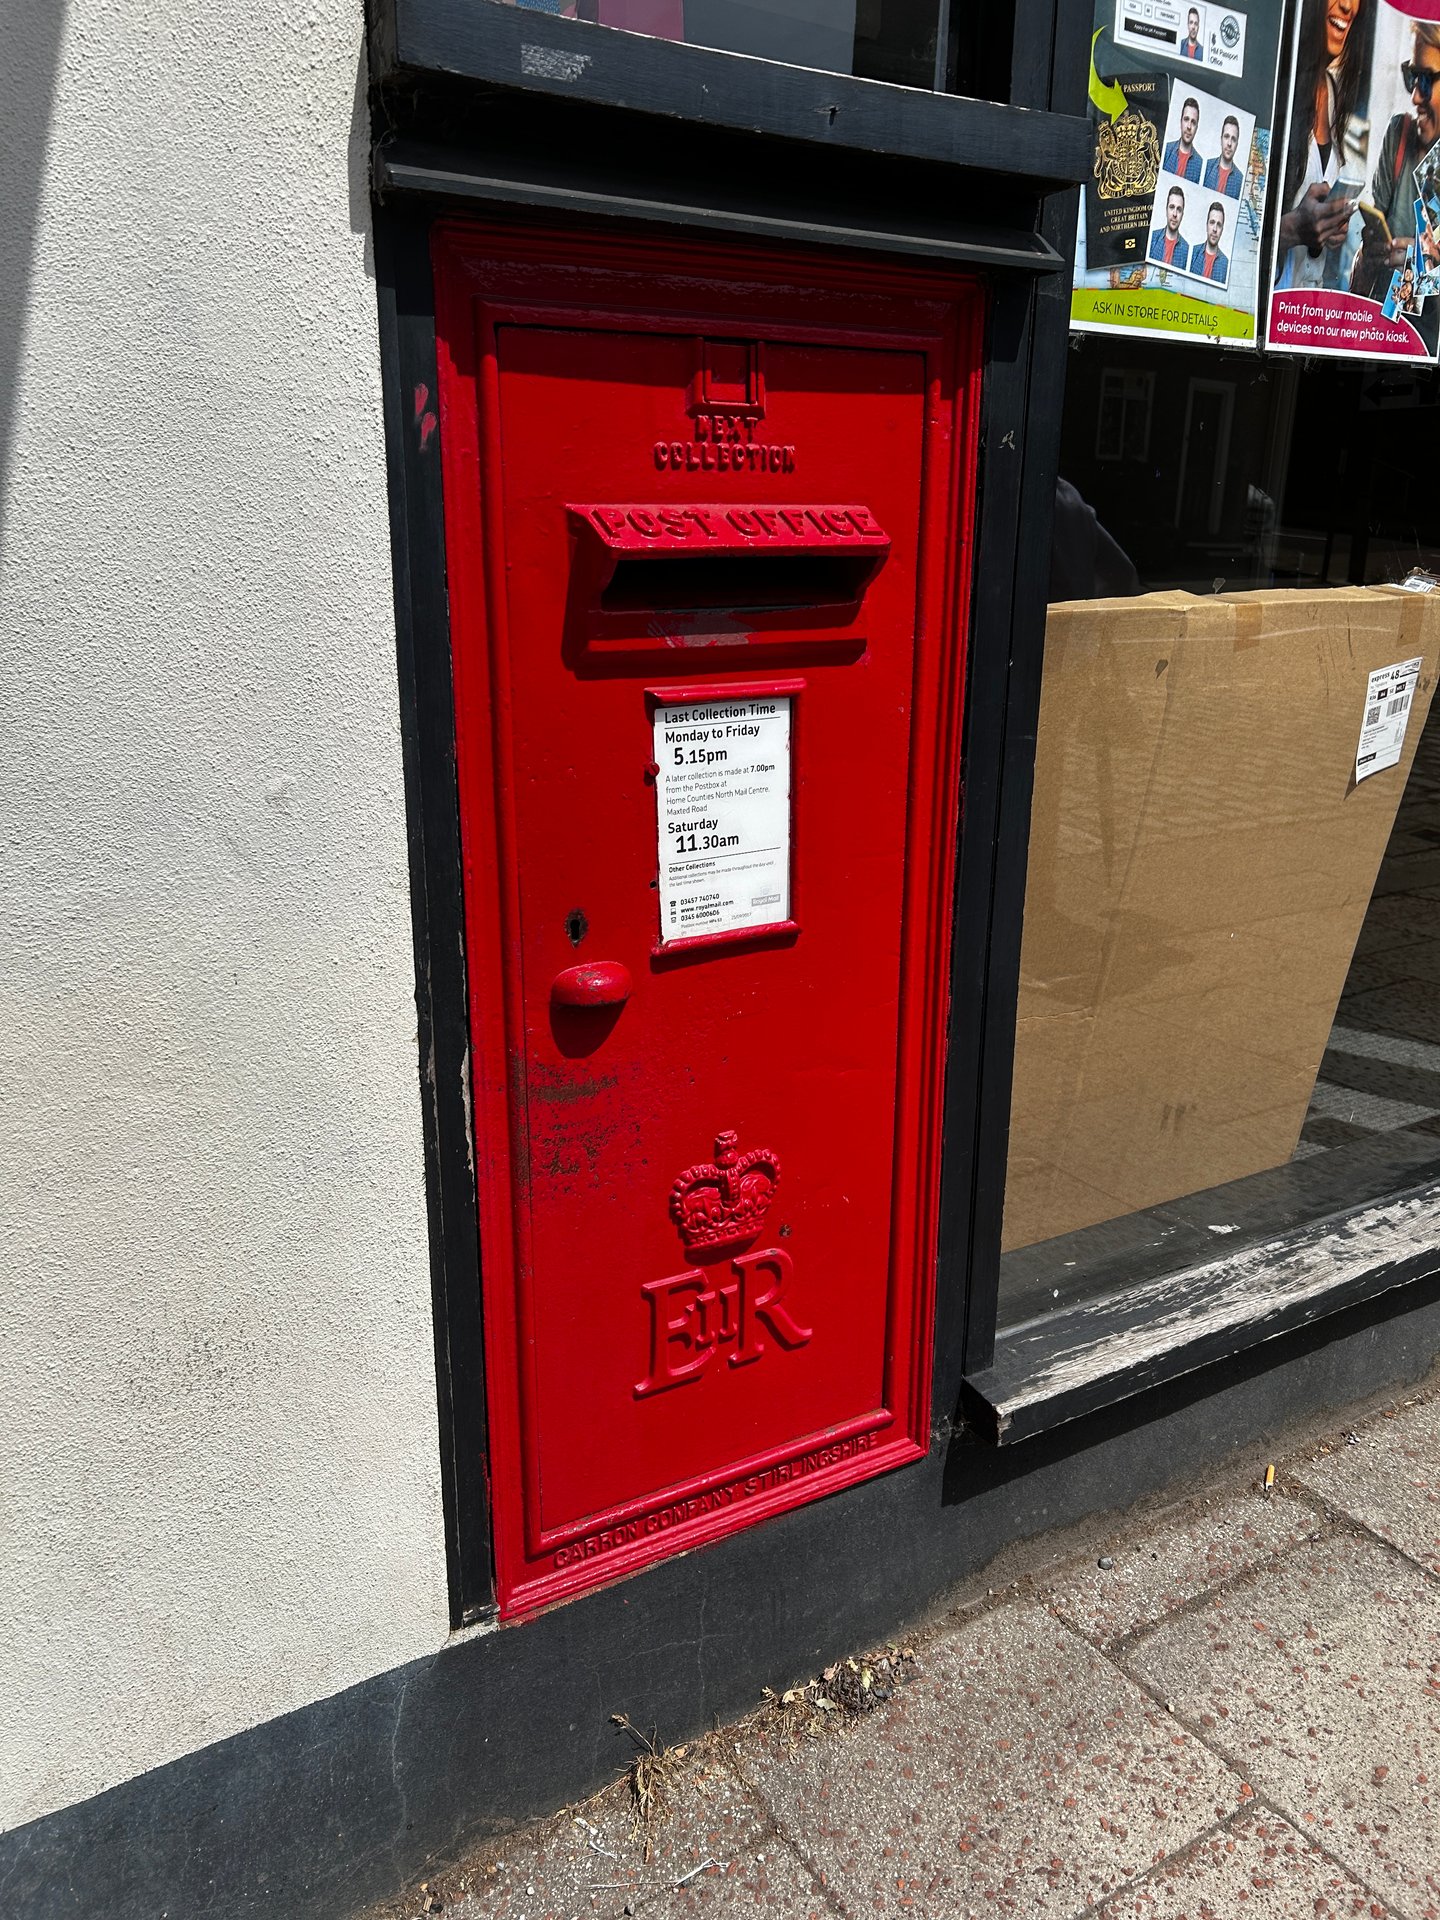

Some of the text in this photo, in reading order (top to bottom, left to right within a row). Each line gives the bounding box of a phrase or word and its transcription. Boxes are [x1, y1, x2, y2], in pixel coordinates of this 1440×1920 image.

[1220, 48, 1238, 61] Passport
[1124, 83, 1155, 92] PASSPORT
[1104, 209, 1122, 217] UNITED
[1111, 215, 1127, 223] GREAT
[1111, 222, 1137, 231] NORTHERN
[1092, 301, 1218, 327] ASK IN STORE FOR DETAILS
[1279, 302, 1372, 322] Print from your mobile
[1277, 320, 1409, 343] devices on our new photo kiosk.
[695, 415, 758, 443] NEXT
[654, 441, 796, 473] COLLECTION
[592, 508, 884, 539] POST OFFICE
[1371, 670, 1400, 682] express 48
[665, 704, 776, 723] Last Collection Time
[666, 725, 760, 744] Monday to Friday
[674, 747, 727, 765] 5.15pm
[672, 774, 686, 782] later
[688, 771, 717, 780] collection
[724, 767, 742, 776] made
[750, 764, 775, 772] 7.00pm
[695, 782, 719, 791] Postbox
[667, 797, 686, 805] Home
[687, 794, 714, 803] Counties
[667, 804, 708, 816] Maxted Road
[668, 818, 718, 834] Saturday
[676, 834, 739, 853] 11.30am
[686, 861, 715, 871] Collections
[680, 893, 719, 906] 03457 740740
[680, 900, 734, 913] www.royalmail.com
[681, 910, 720, 922] 0345 6000606
[553, 1432, 879, 1570] CARRON COMPANY STIRLINGSHIRE
